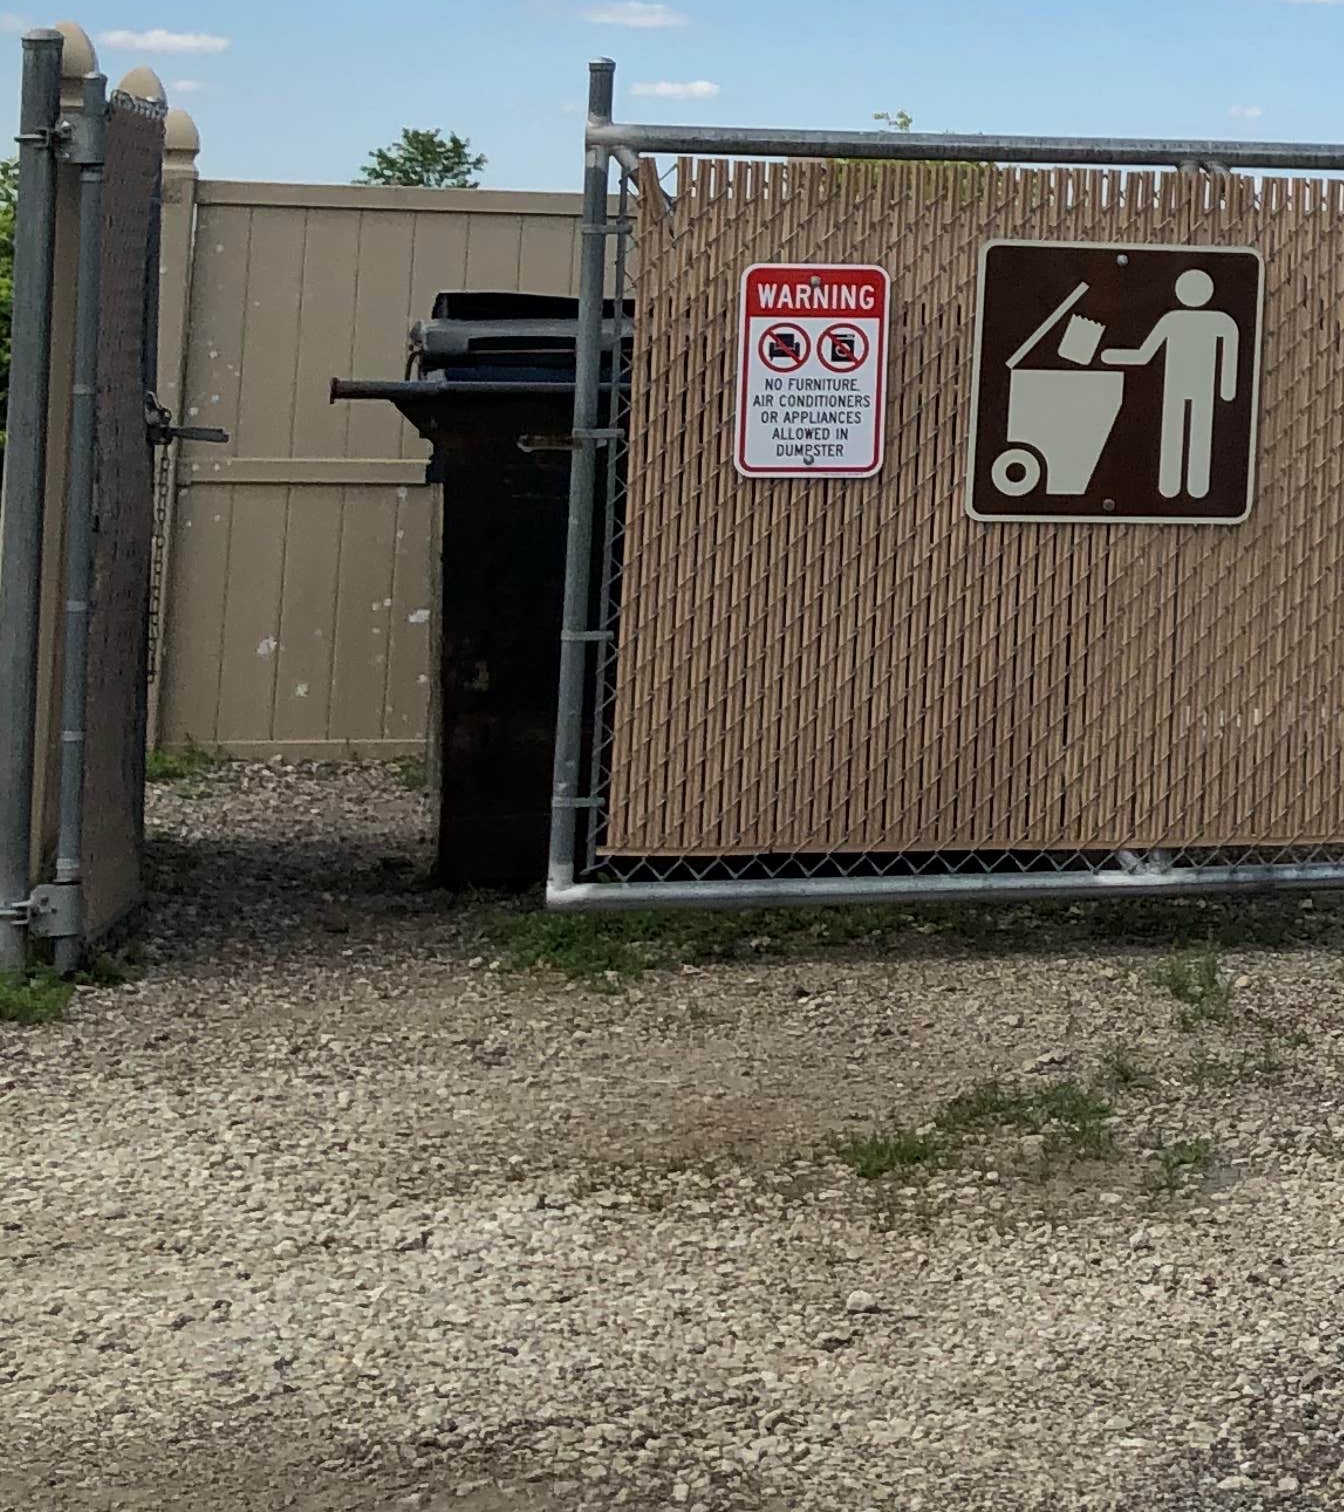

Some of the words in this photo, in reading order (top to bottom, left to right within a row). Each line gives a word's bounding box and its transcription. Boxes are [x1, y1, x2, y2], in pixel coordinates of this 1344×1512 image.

[758, 283, 875, 310] WARNING
[765, 378, 783, 391] NO
[788, 378, 858, 391] FURNITURE
[752, 395, 774, 407] AIR
[779, 395, 871, 408] CONDITIONERS
[761, 411, 778, 424] OR
[783, 411, 862, 424] APPLIANCES
[772, 428, 830, 440] ALLOWED
[836, 428, 849, 440] IN
[776, 444, 844, 457] DUMPSTER
